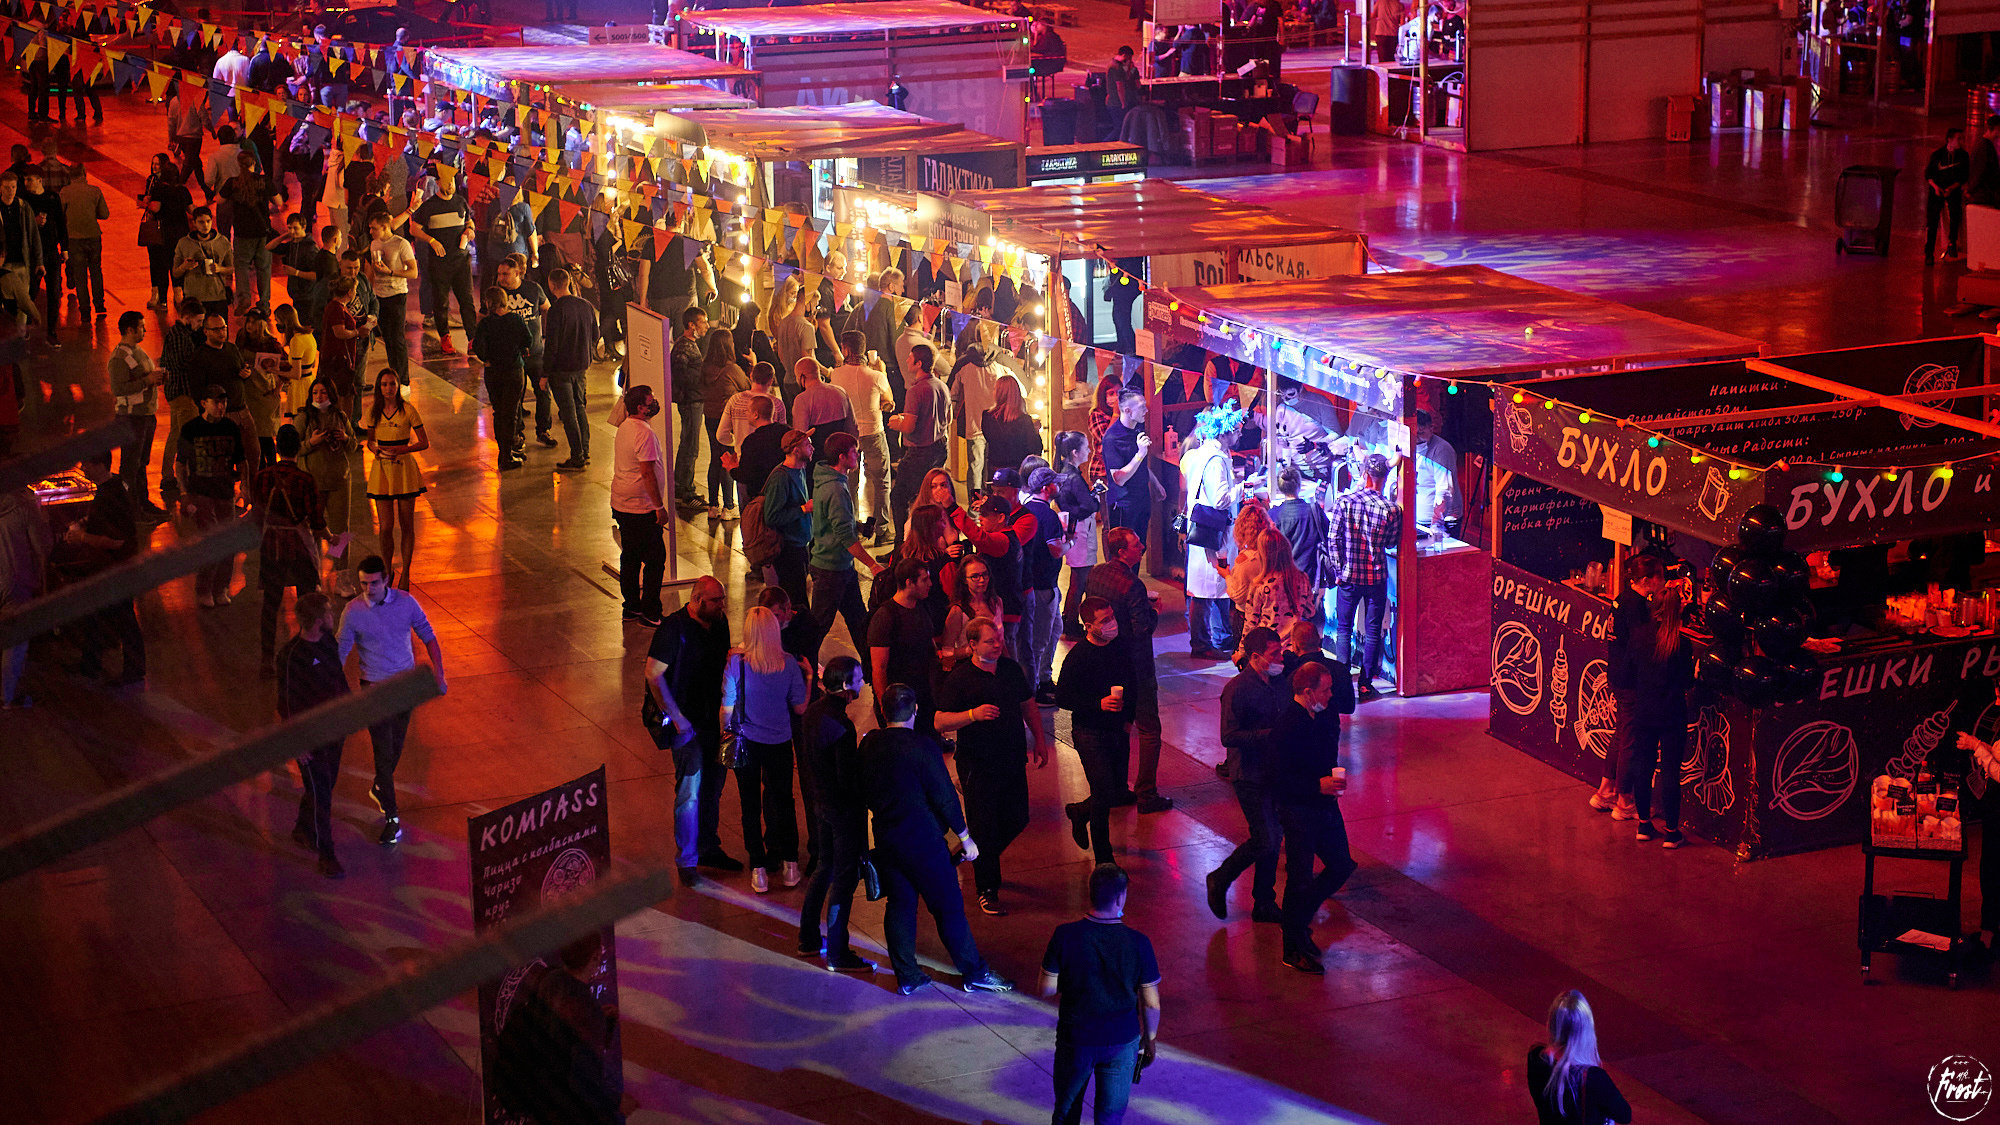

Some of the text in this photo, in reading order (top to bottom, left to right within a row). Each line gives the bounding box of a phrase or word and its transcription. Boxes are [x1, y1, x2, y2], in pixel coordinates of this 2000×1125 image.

[1709, 382, 1779, 397] Напитки
[1557, 427, 1668, 496] БУХЛО
[1504, 499, 1575, 517] Картофель
[1504, 517, 1542, 532] Рыбка
[1786, 469, 1951, 530] БУХЛО
[1493, 575, 1571, 624] ОРЕШКИ
[480, 783, 598, 851] KOMPASS
[483, 857, 519, 880] Пицца
[529, 824, 598, 860] колбасками
